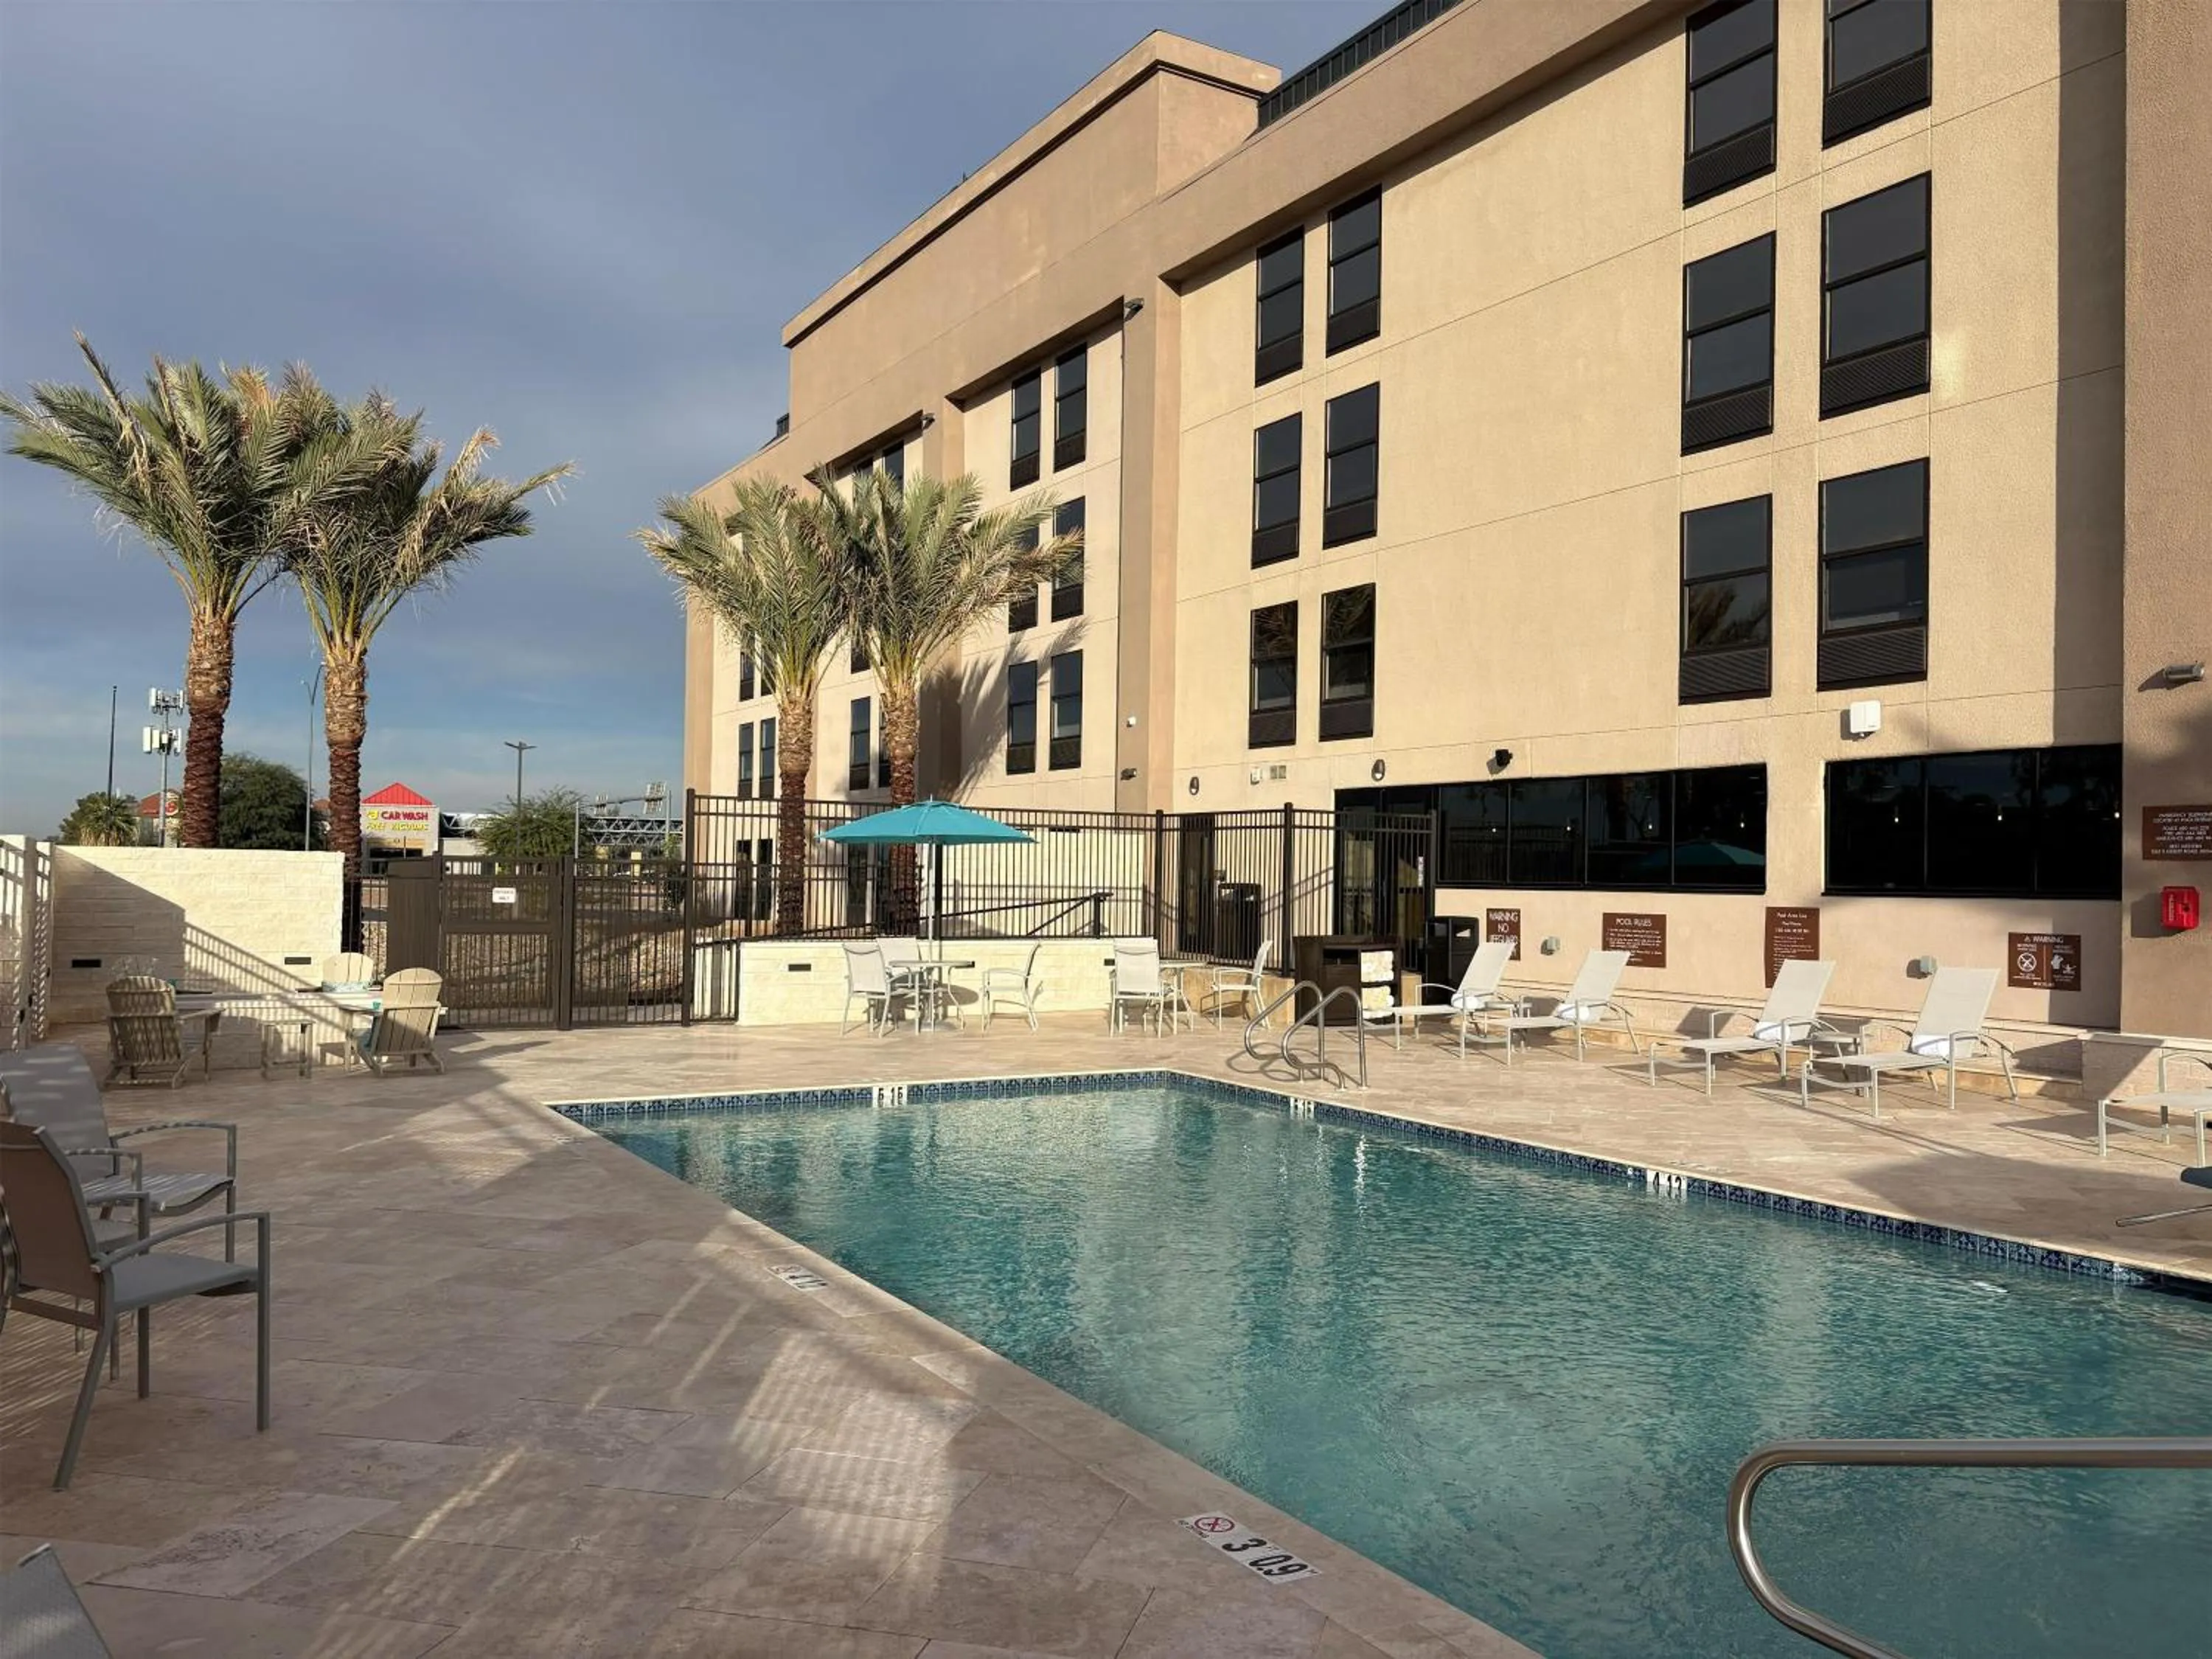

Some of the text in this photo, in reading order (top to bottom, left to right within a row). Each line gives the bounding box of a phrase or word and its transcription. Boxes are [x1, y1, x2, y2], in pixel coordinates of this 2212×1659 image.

[381, 811, 428, 821] CAR WASH
[1489, 911, 1518, 922] WARNING
[1633, 918, 1652, 926] RULES
[1498, 922, 1509, 933] NO
[1222, 1537, 1267, 1552] 3
